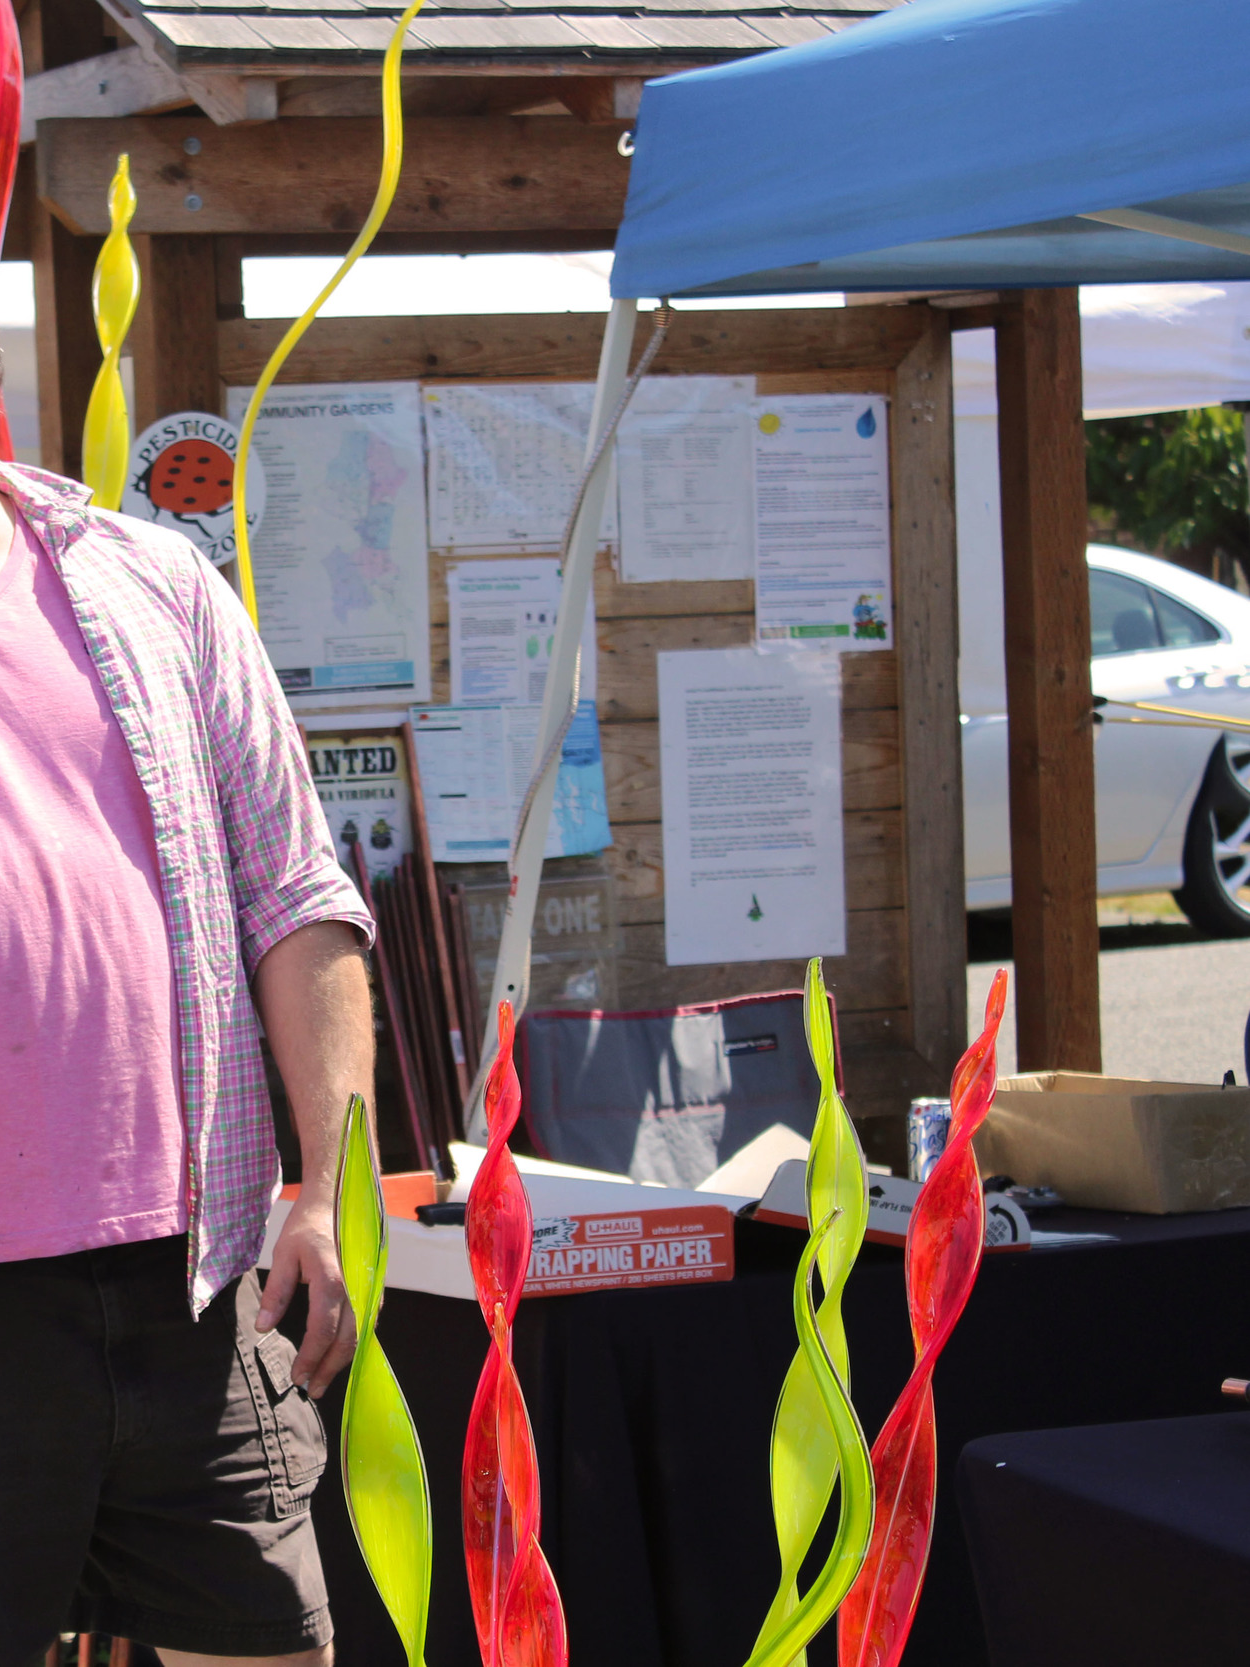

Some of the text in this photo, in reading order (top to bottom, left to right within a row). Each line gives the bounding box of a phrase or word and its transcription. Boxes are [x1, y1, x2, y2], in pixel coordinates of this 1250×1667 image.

[330, 402, 395, 417] GARDENS
[138, 419, 239, 465] PESTICID
[207, 512, 257, 560] ZOE
[308, 747, 396, 776] ANTED
[543, 895, 602, 936] ONE
[909, 1126, 946, 1161] Shas
[640, 1241, 712, 1268] PAPER
[524, 1283, 543, 1292] EAN,
[544, 1281, 571, 1291] WHITE
[643, 1273, 675, 1283] SHEETS
[677, 1270, 693, 1280] PER
[695, 1269, 713, 1278] BOX
